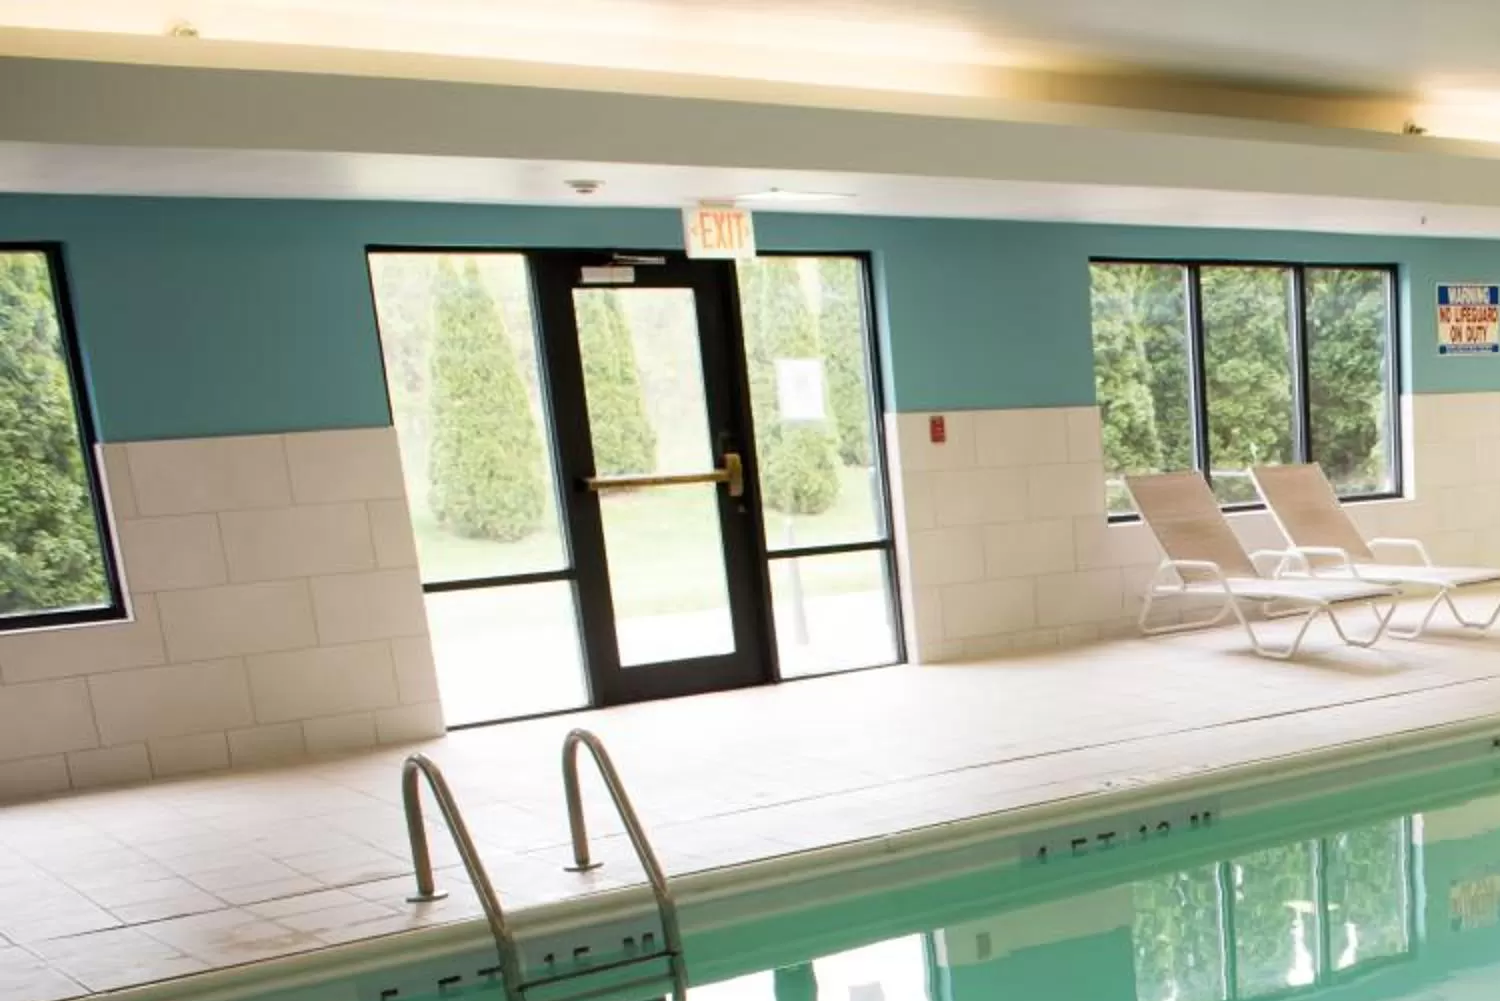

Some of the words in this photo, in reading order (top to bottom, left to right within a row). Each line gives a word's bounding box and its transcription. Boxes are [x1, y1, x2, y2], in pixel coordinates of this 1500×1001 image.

[699, 211, 745, 249] EXIT
[1440, 307, 1451, 322] NO
[1455, 307, 1497, 322] LIFEGUARD
[1450, 326, 1462, 341] ON
[1466, 326, 1487, 341] DUTY
